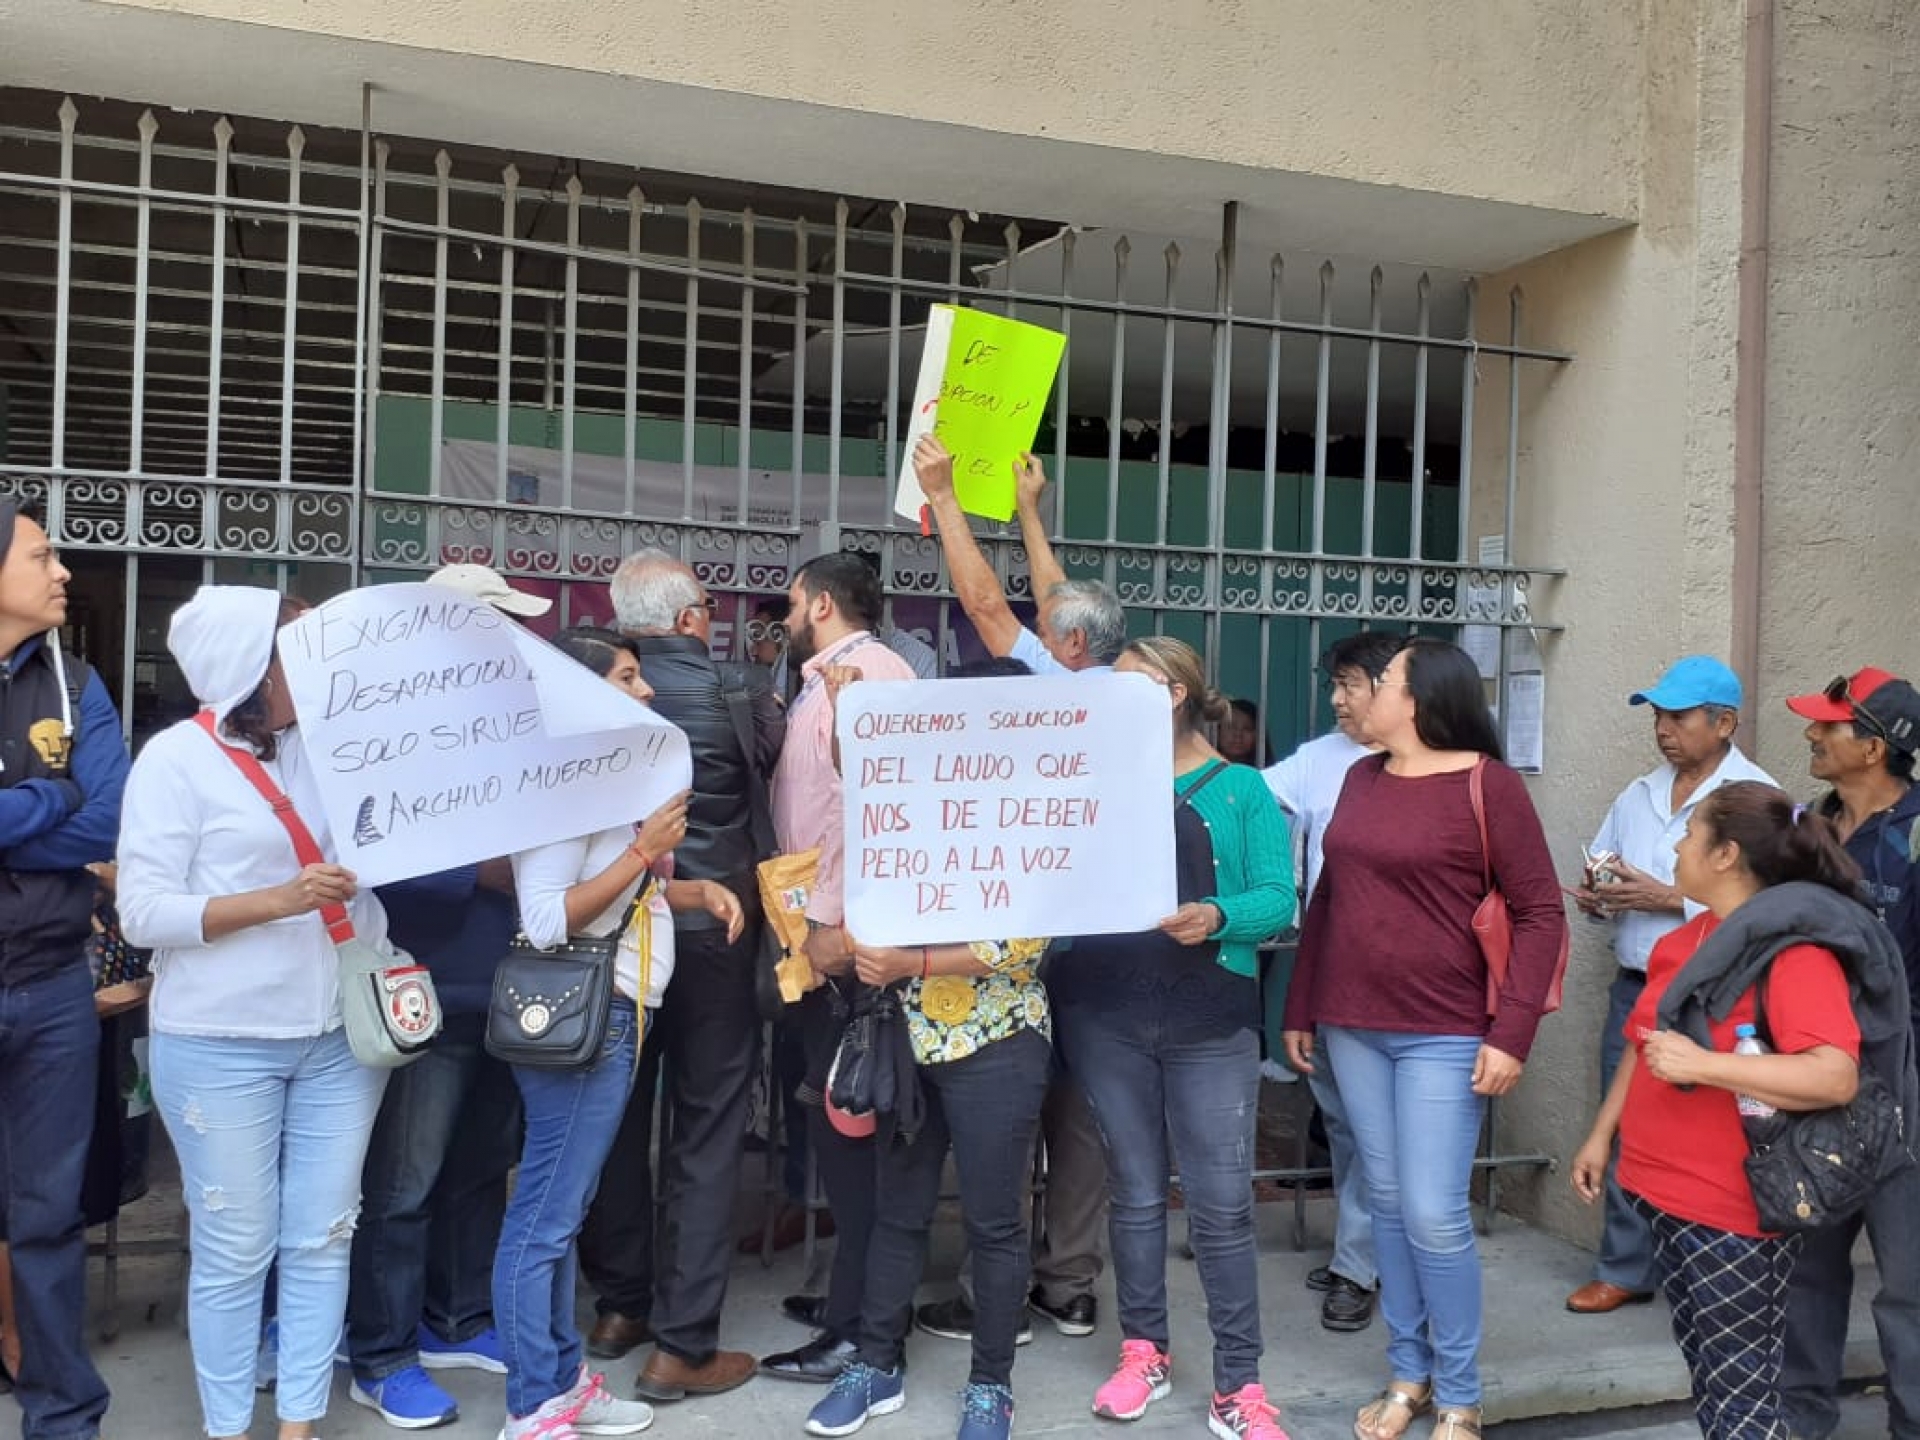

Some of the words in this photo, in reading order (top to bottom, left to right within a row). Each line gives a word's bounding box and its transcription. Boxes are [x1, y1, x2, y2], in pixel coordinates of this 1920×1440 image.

[854, 712, 967, 740] QUEREMOS
[331, 733, 418, 772] SOLO
[860, 757, 914, 789] DEL
[935, 754, 1014, 783] LAUDO
[1036, 753, 1090, 779] QUE
[862, 803, 910, 839] NOS
[942, 799, 978, 830] DE
[999, 797, 1100, 828] DEBEN
[860, 847, 929, 879] PERO
[944, 848, 959, 873] A
[971, 846, 1005, 872] LA
[1021, 846, 1073, 874] VOZ
[917, 883, 957, 915] DE
[980, 880, 1010, 908] YA
